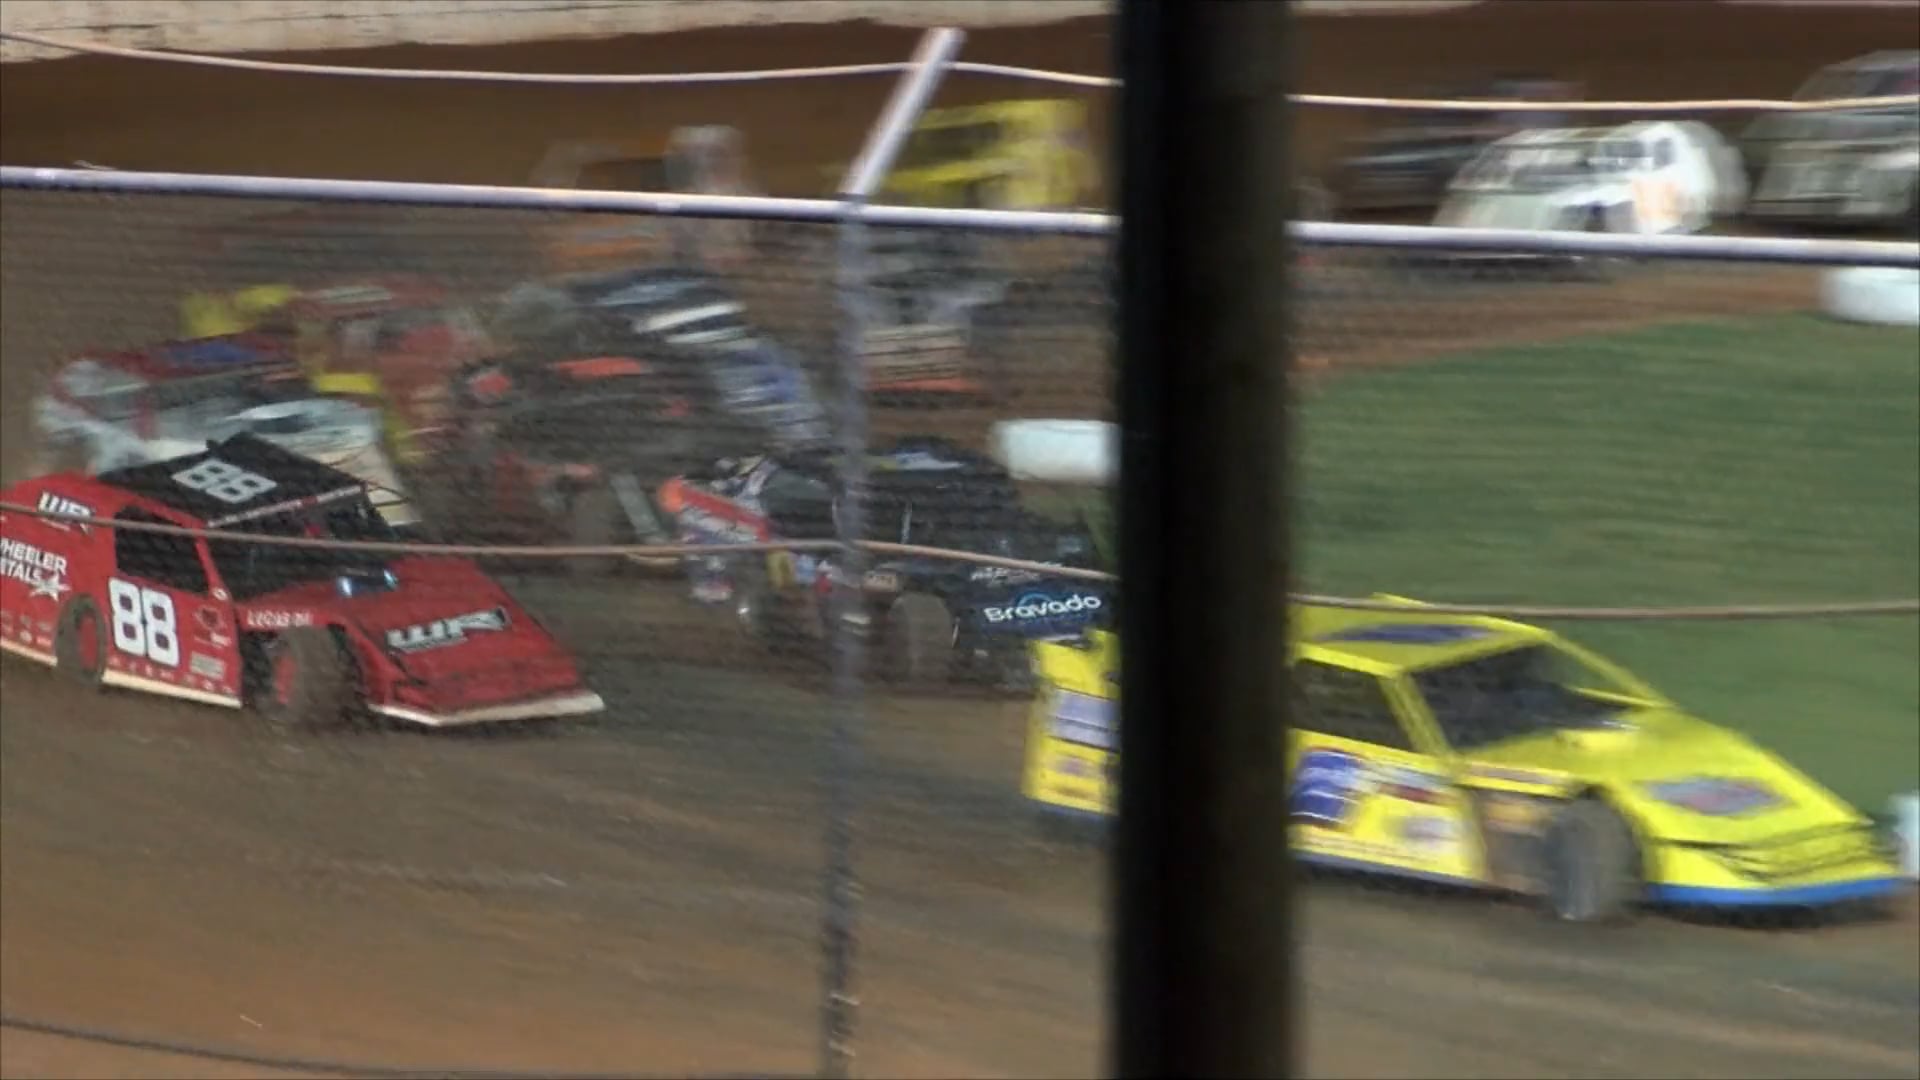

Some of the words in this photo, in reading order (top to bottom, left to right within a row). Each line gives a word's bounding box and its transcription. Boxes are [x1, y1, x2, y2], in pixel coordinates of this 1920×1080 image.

[171, 459, 278, 504] 88
[109, 576, 179, 668] 88
[984, 594, 1102, 622] Bravado
